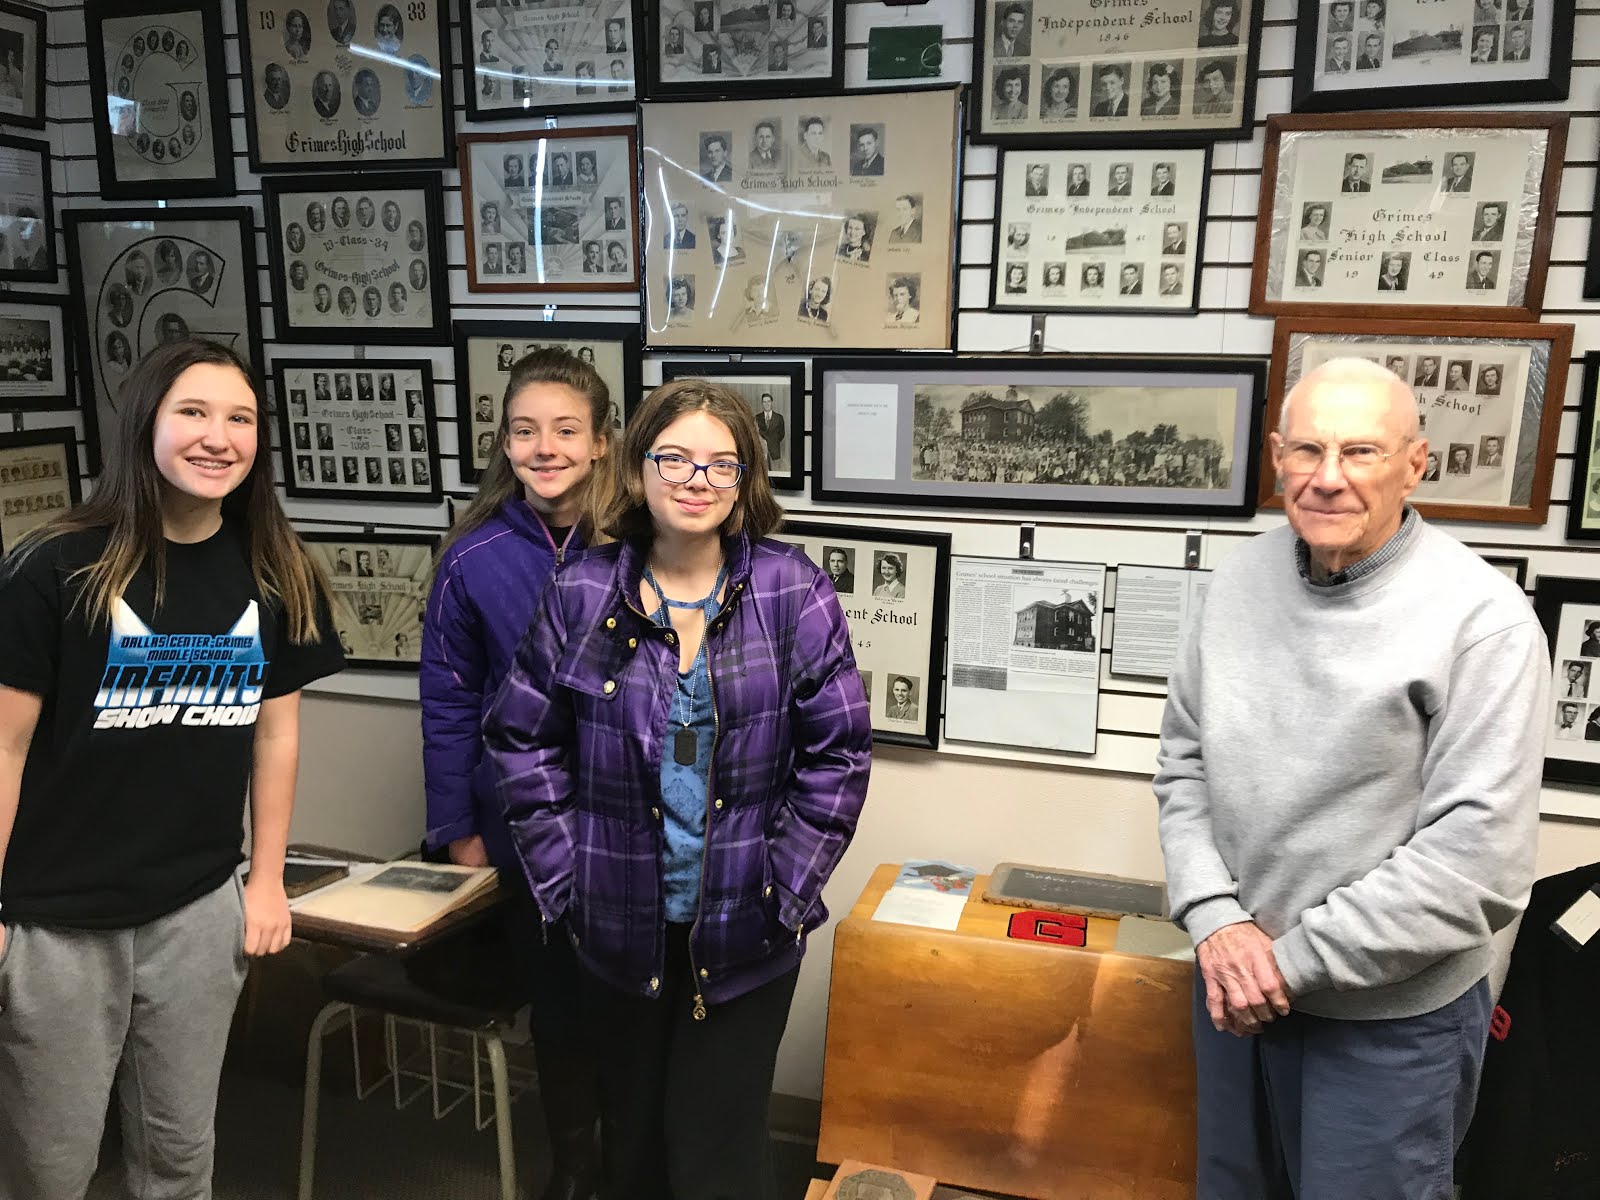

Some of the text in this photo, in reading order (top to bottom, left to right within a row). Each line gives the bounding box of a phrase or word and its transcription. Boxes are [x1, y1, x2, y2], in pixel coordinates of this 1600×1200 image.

[1038, 8, 1193, 35] Independent School
[285, 129, 406, 157] Grimes High School
[740, 177, 777, 190] Grimes
[777, 176, 805, 191] High
[1026, 202, 1176, 216] Grimes Independent School
[1372, 208, 1433, 222] Grimes
[1340, 226, 1447, 245] High School
[1327, 247, 1460, 263] Senior Class
[1428, 271, 1444, 280] 49
[1431, 393, 1482, 415] School
[346, 426, 372, 434] Class
[870, 609, 917, 626] School
[120, 635, 168, 648] DALLAS
[146, 649, 234, 661] MIDDLE SCHOOL
[93, 662, 269, 708] INFINITY
[93, 704, 180, 729] SHOW
